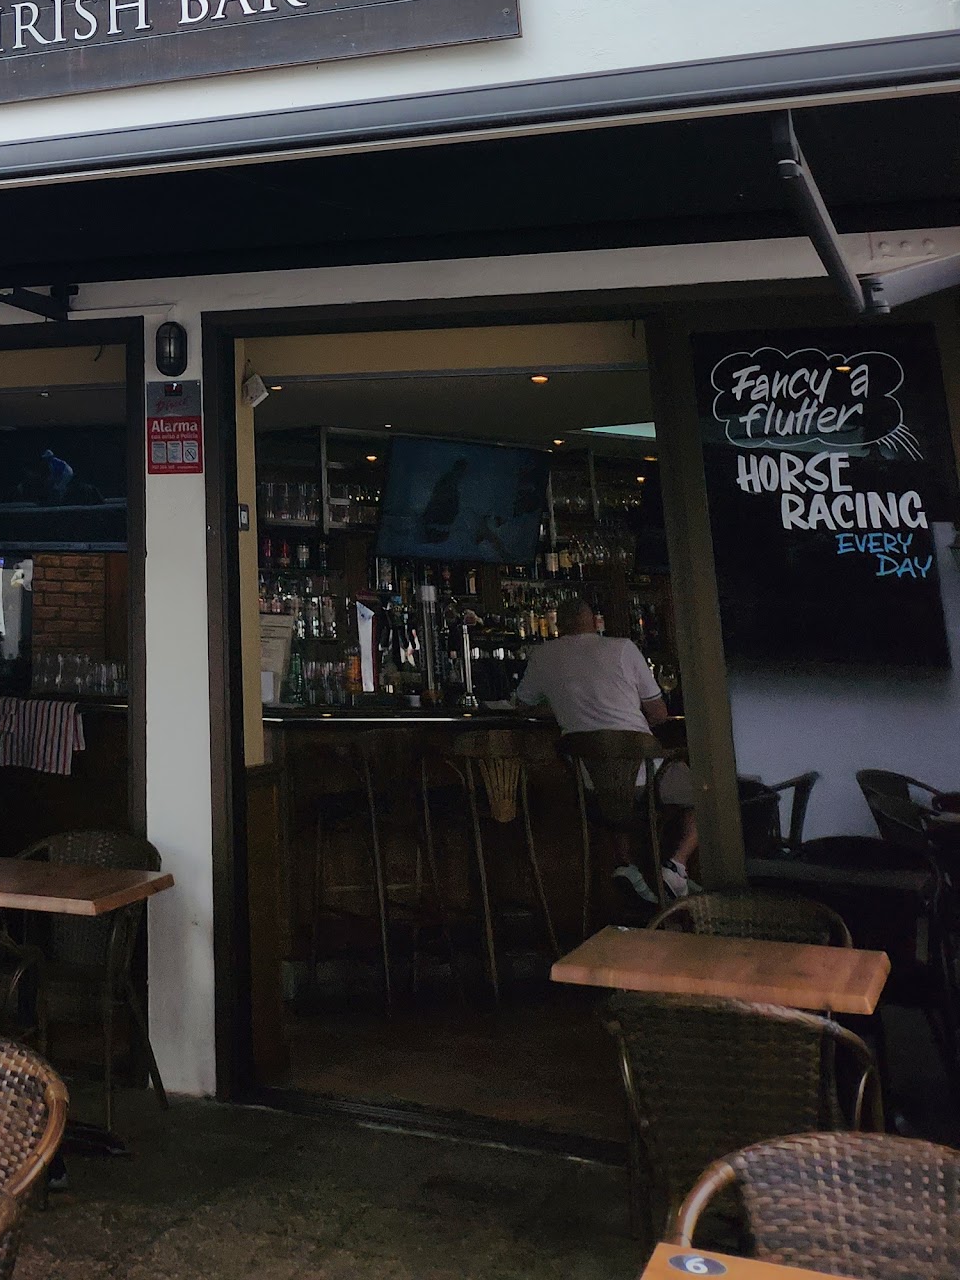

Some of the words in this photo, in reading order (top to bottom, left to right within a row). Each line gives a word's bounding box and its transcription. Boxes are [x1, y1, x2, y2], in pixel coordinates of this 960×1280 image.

[731, 365, 832, 403] Fancy
[850, 364, 869, 398] a
[152, 419, 198, 433] Alarma
[739, 397, 863, 438] flutter
[736, 451, 852, 493] HORSE
[781, 490, 928, 531] RACING
[835, 532, 913, 555] EVERY
[875, 555, 933, 578] DAY
[685, 1257, 708, 1274] 6
